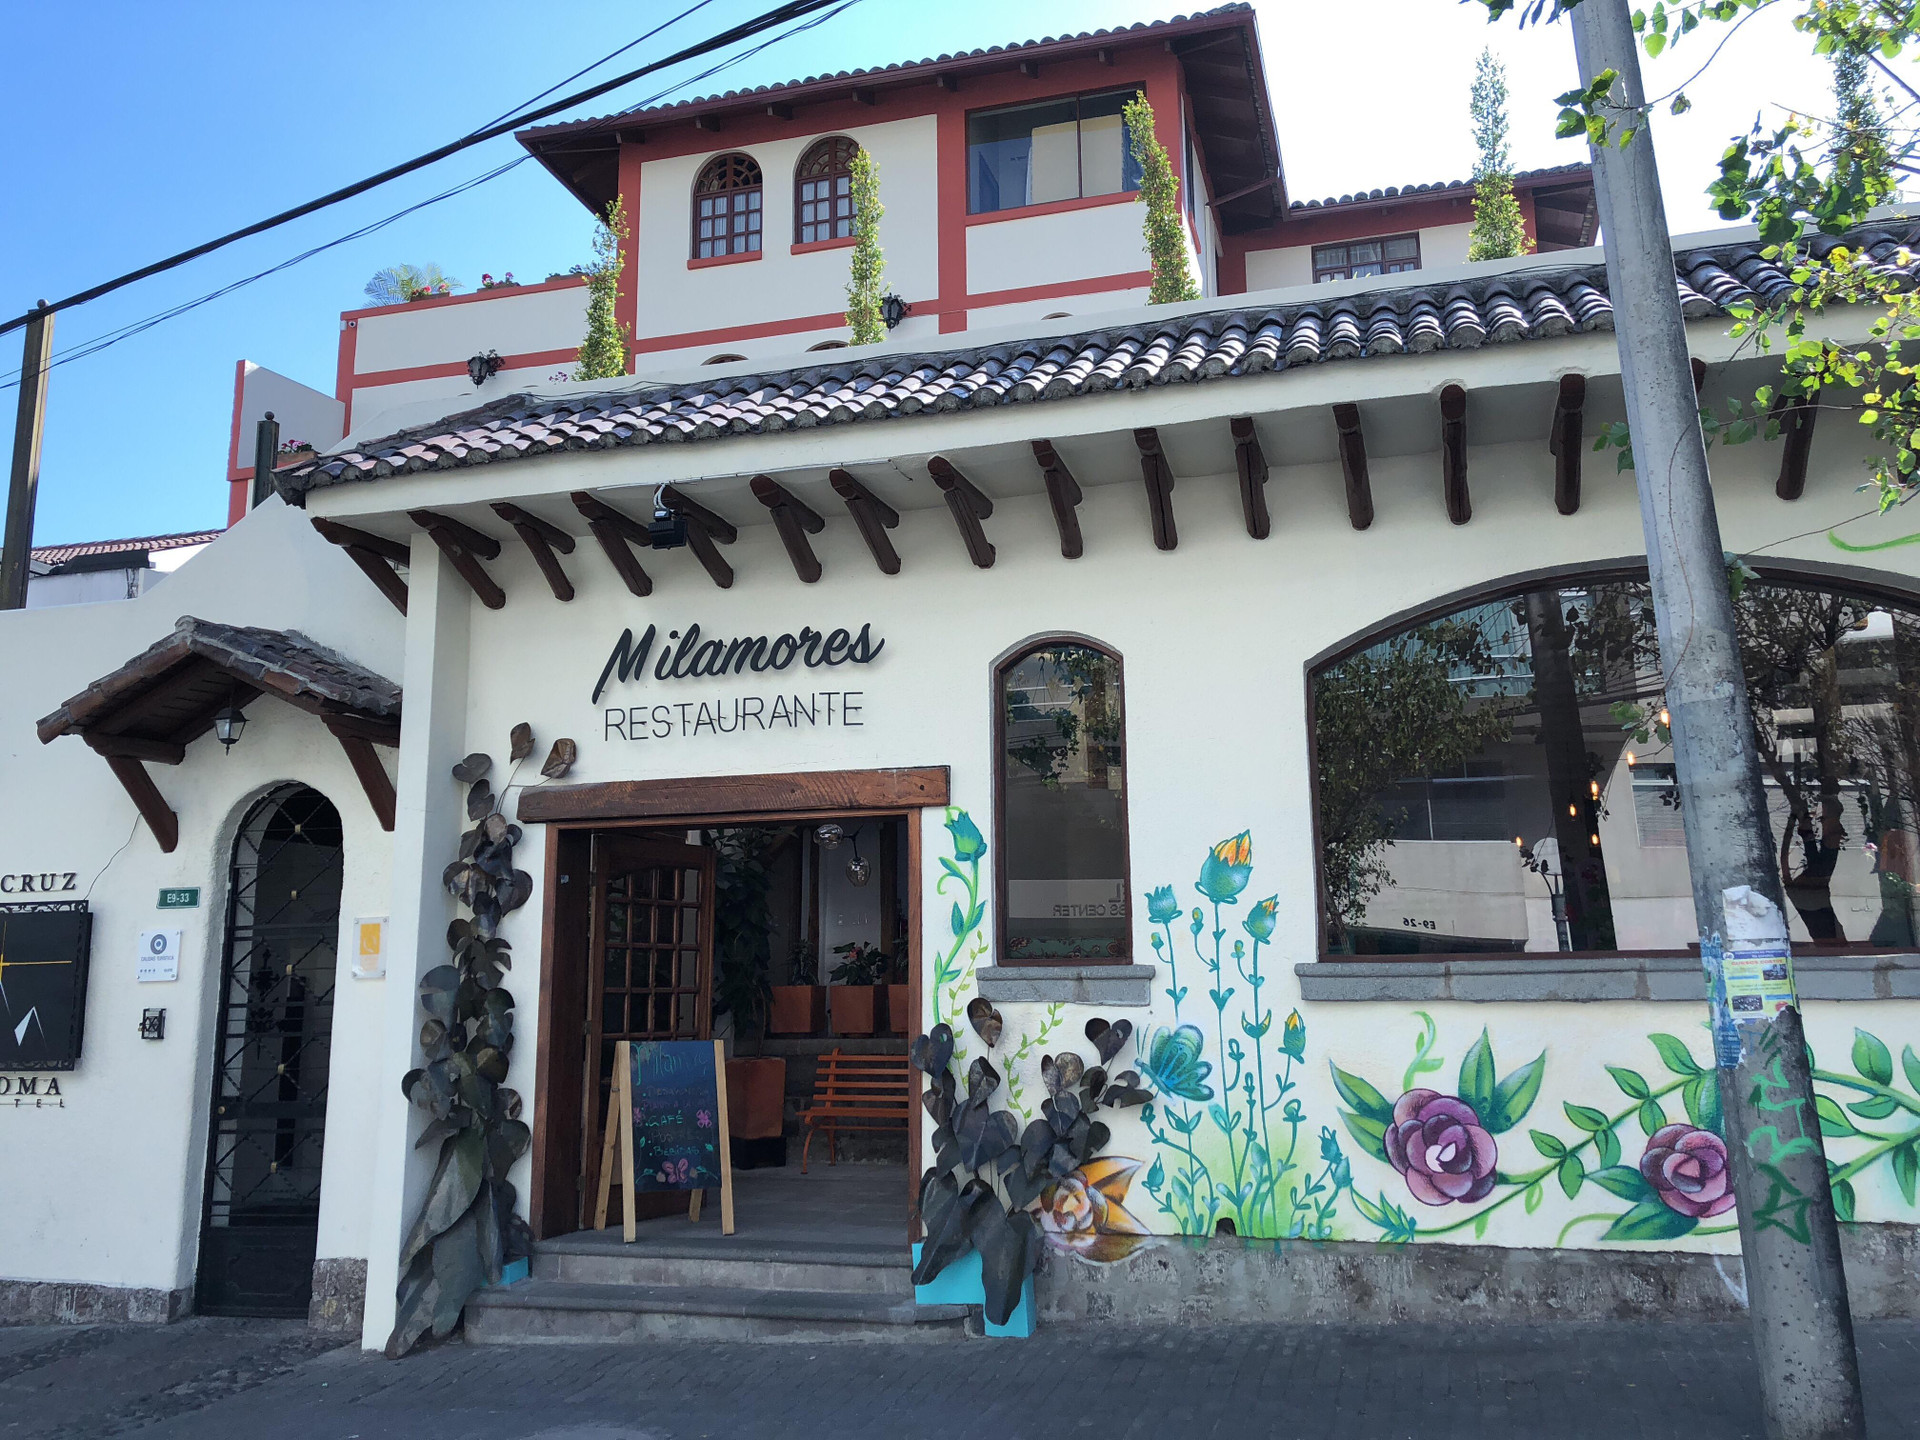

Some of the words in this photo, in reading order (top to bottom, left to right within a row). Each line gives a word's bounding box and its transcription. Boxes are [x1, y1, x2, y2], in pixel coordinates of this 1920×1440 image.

[591, 623, 885, 705] Milamores
[605, 691, 864, 742] RESTAURANTE
[0, 873, 77, 893] CRUZ
[166, 893, 190, 903] E9-33
[648, 1109, 684, 1127] CAFÉ
